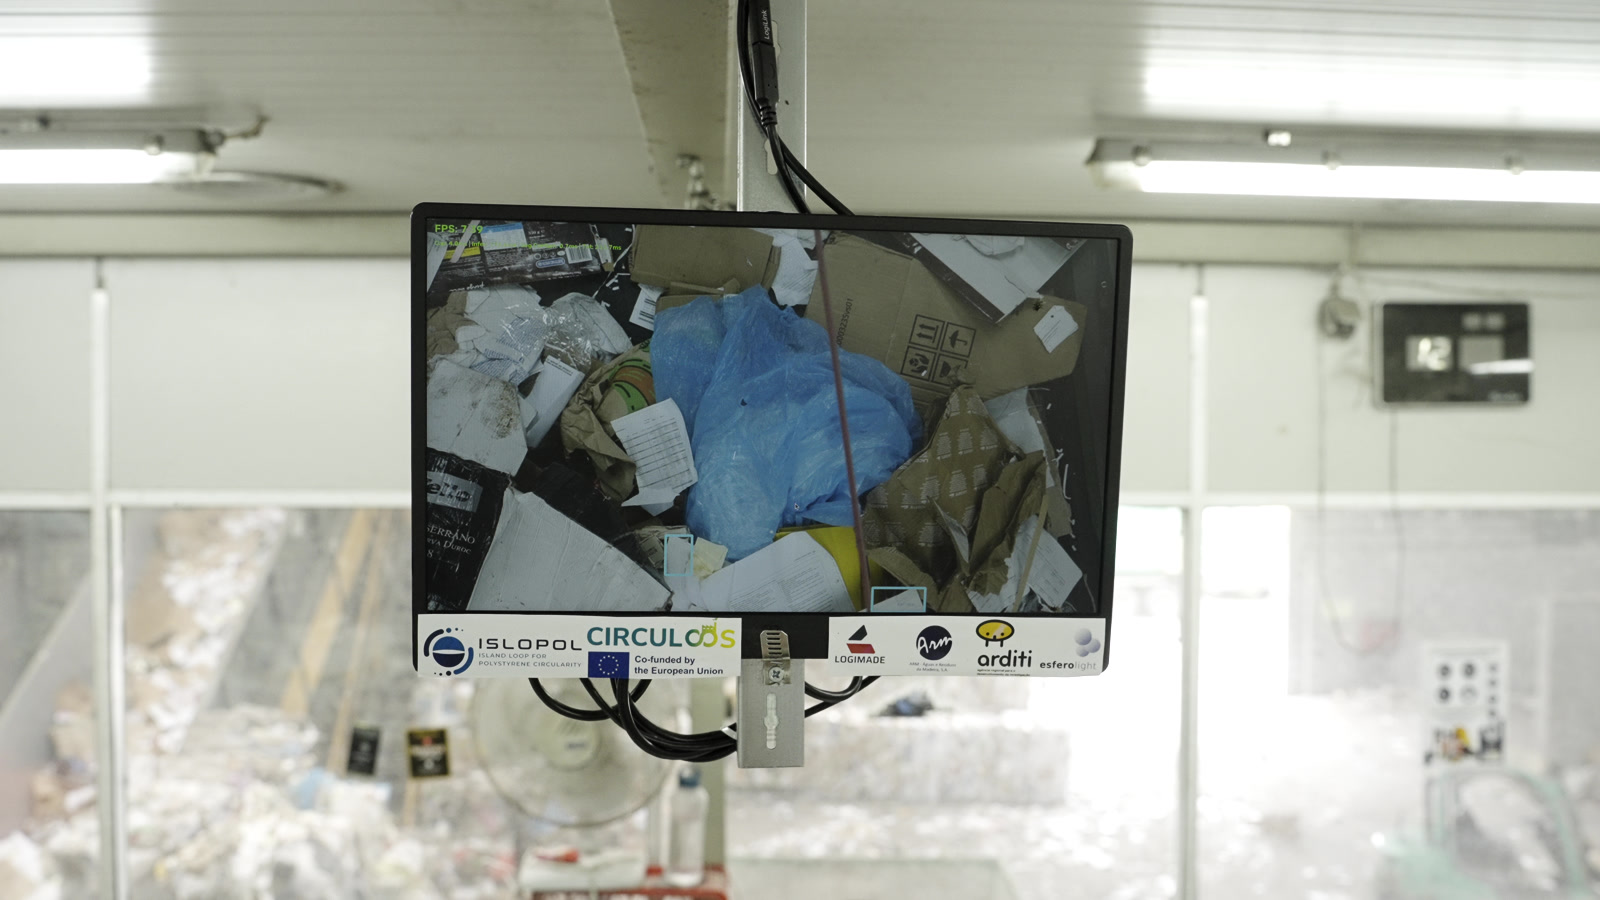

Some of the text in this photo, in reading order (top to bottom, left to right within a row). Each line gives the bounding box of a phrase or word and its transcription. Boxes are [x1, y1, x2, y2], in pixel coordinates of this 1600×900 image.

[761, 9, 771, 40] LogiLink
[434, 224, 458, 233] FPS:
[478, 638, 583, 651] ISLOPOL
[634, 655, 696, 666] Co-funded by
[834, 655, 886, 664] LOGIMADE
[977, 649, 1033, 668] arditi
[1039, 660, 1097, 671] esferolight
[634, 667, 724, 676] the European Union
